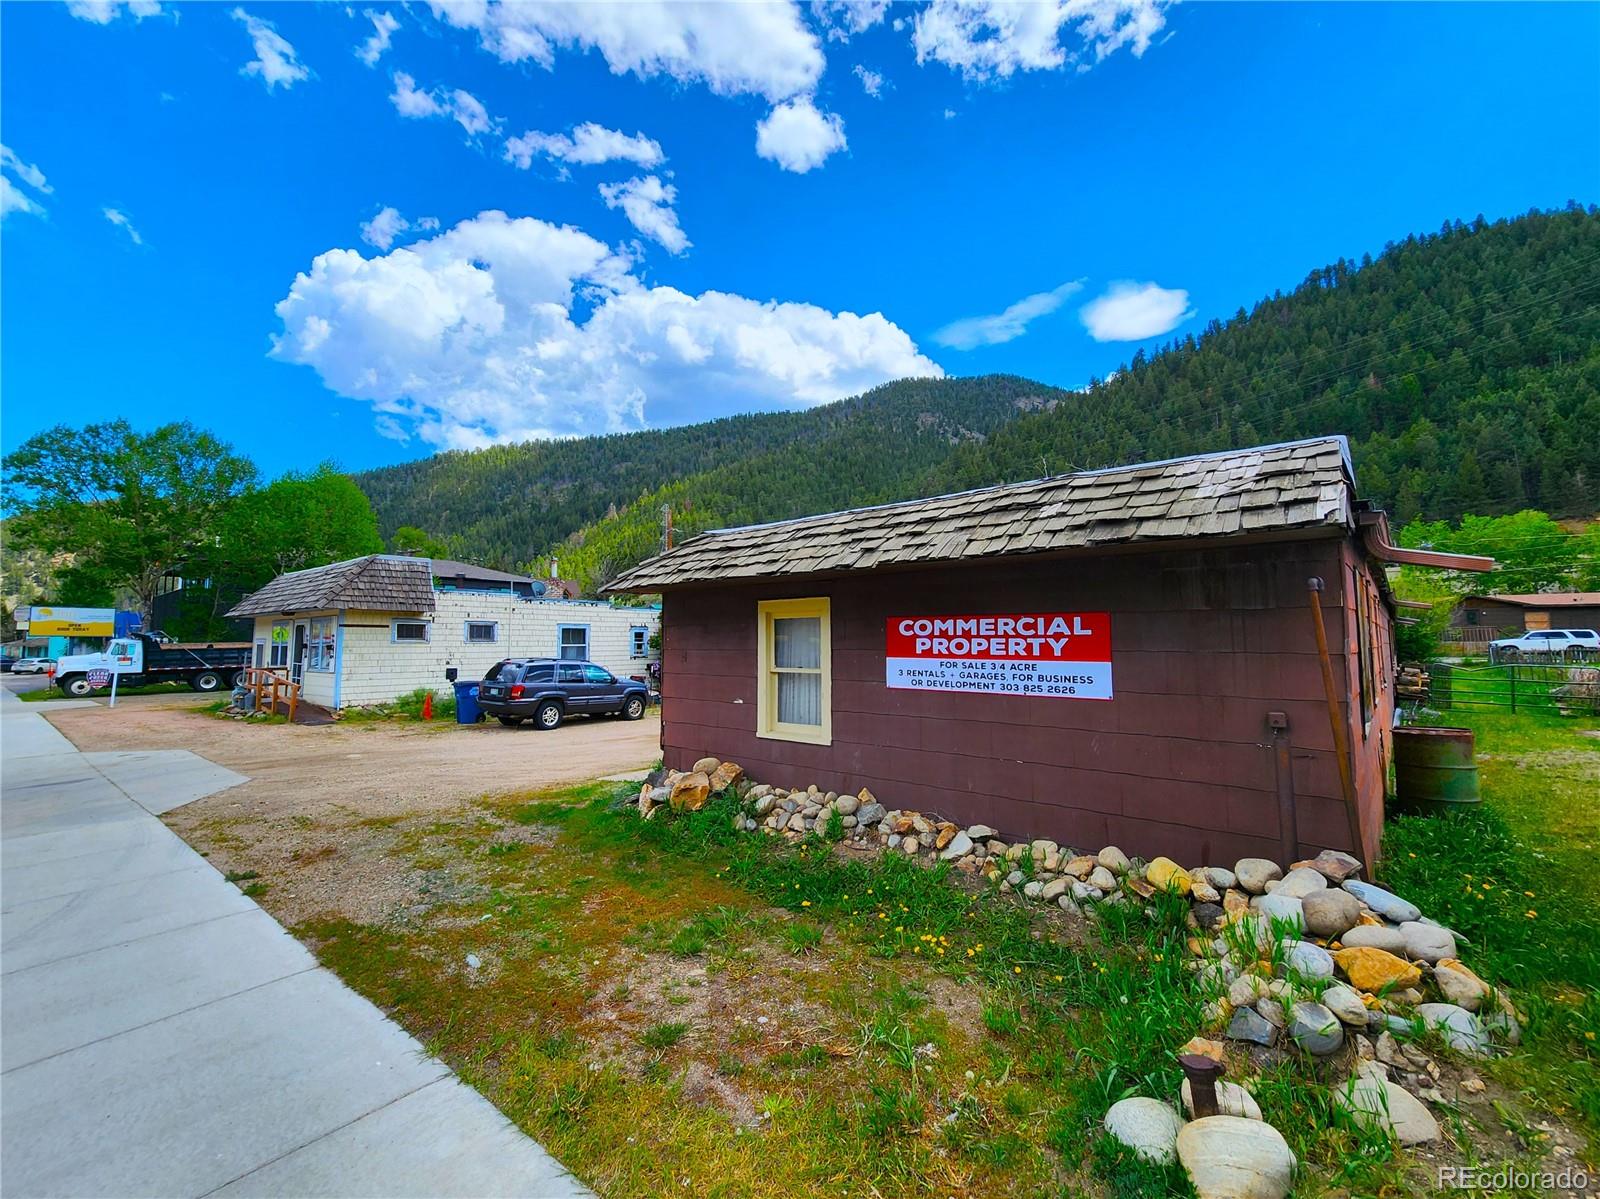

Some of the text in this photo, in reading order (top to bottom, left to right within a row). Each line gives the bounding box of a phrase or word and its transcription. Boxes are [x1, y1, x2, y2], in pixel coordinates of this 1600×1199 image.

[898, 617, 1092, 636] COMMERCIAL
[915, 637, 1069, 656] PROPERTY
[939, 661, 958, 669] FOR
[961, 662, 986, 670] SALE
[1009, 663, 1038, 672] ACRE
[898, 669, 904, 677] 3
[906, 669, 946, 679] RENTALS
[1012, 673, 1034, 682] FOR
[1037, 674, 1094, 685] BUSINESS
[911, 678, 924, 687] OR
[926, 679, 996, 690] DEVELOPMENT
